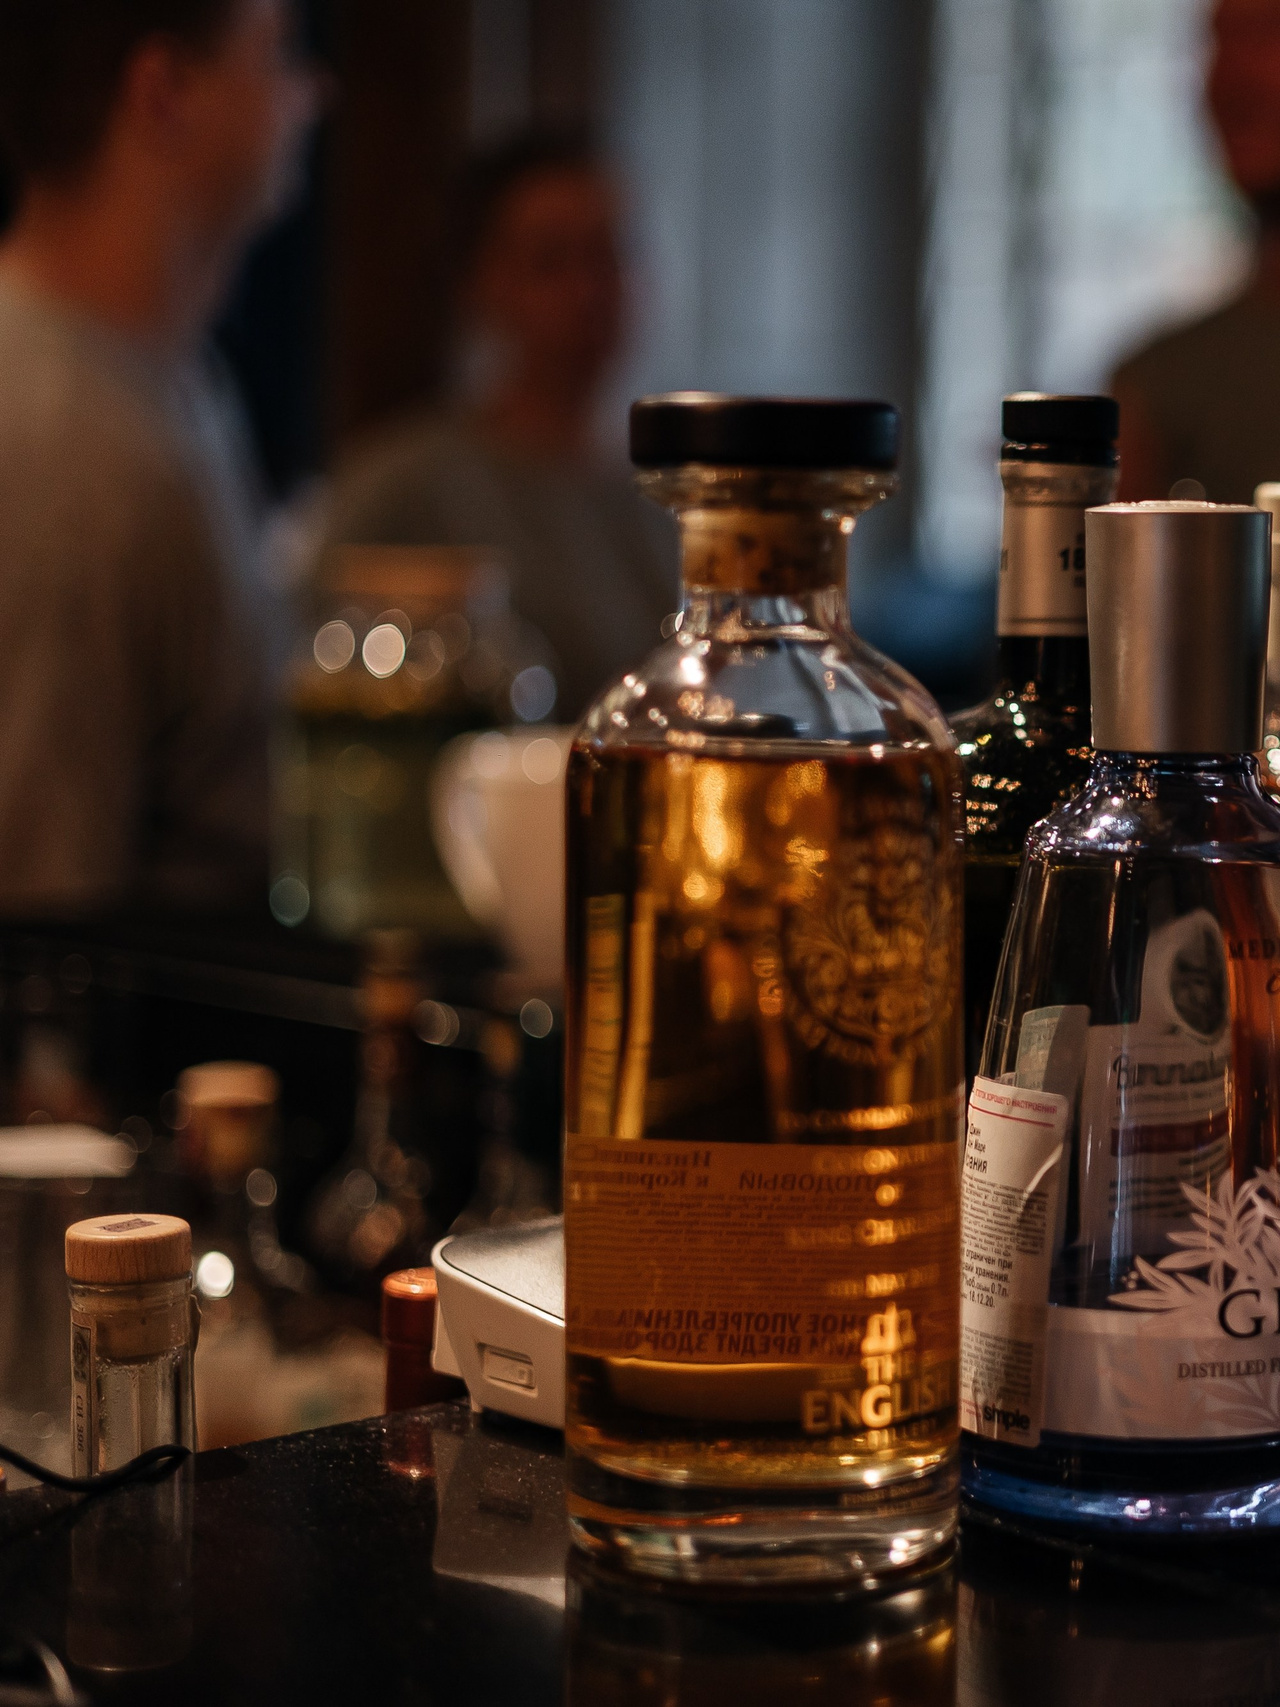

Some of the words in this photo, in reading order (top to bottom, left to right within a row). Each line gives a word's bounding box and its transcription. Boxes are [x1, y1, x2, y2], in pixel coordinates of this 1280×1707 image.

[997, 1258, 1012, 1271] при
[1177, 1359, 1267, 1379] DISTILLED
[801, 1371, 950, 1434] ENGLISH
